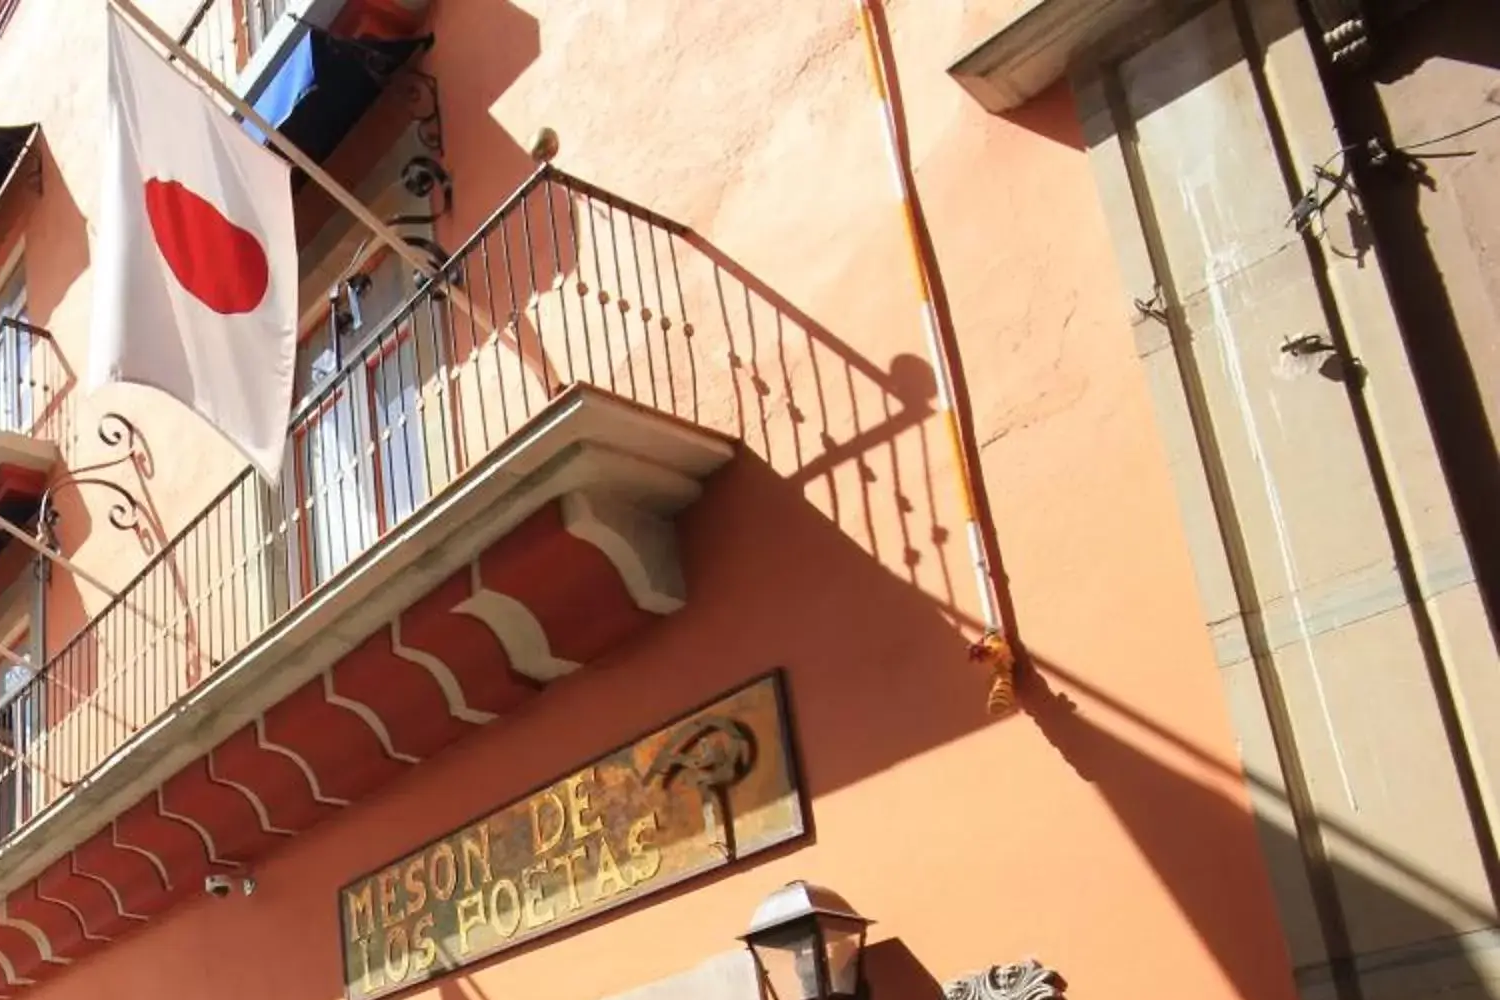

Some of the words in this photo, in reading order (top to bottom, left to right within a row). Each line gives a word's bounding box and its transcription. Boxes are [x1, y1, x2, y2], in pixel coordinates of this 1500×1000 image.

[348, 823, 493, 943] MESON
[528, 765, 602, 856] DE
[358, 911, 436, 994] LOS
[457, 810, 662, 956] POETAS
